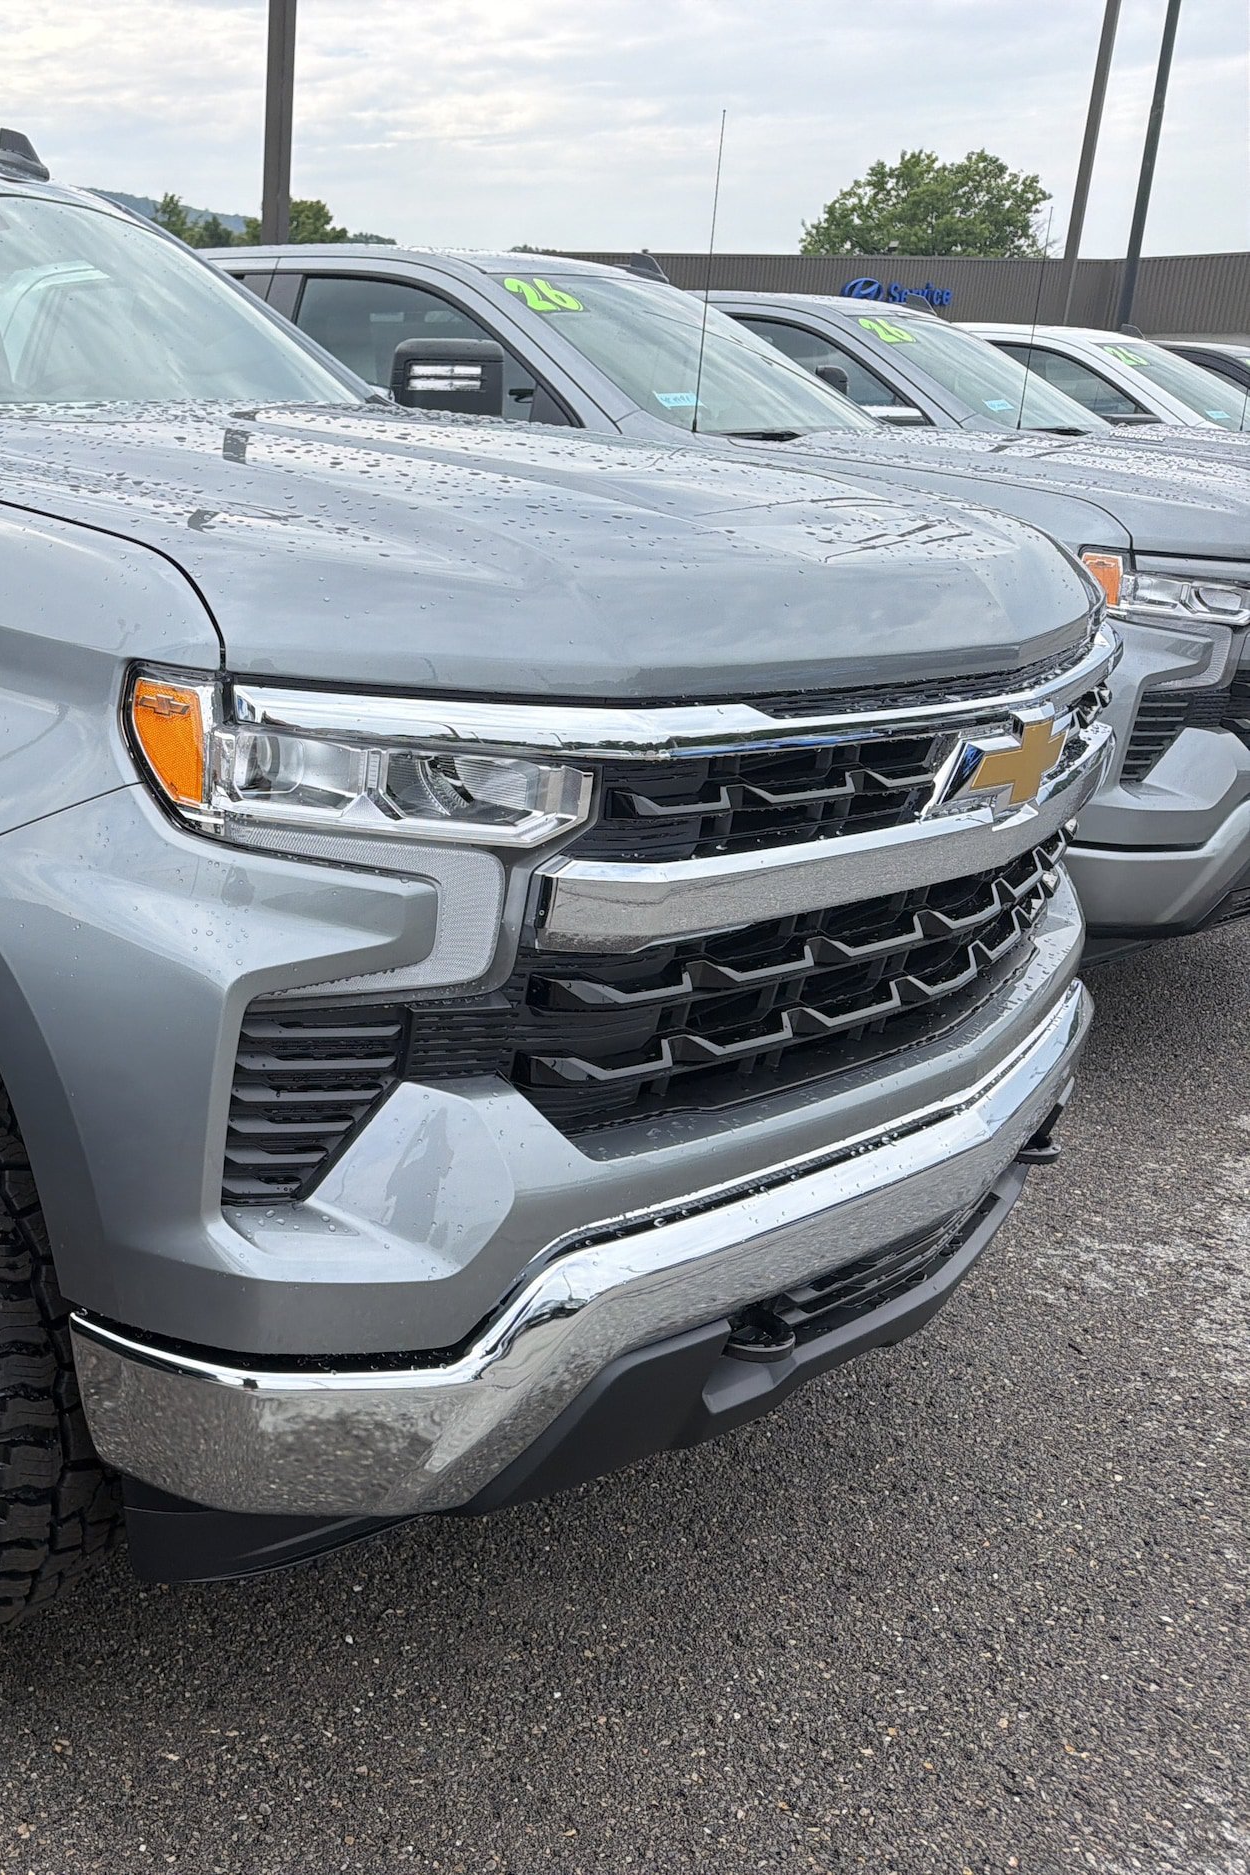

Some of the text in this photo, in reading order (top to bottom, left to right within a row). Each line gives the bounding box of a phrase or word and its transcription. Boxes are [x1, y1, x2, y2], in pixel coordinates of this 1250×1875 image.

[504, 277, 584, 312] 26
[858, 318, 917, 343] 26
[1103, 345, 1148, 366] 26
